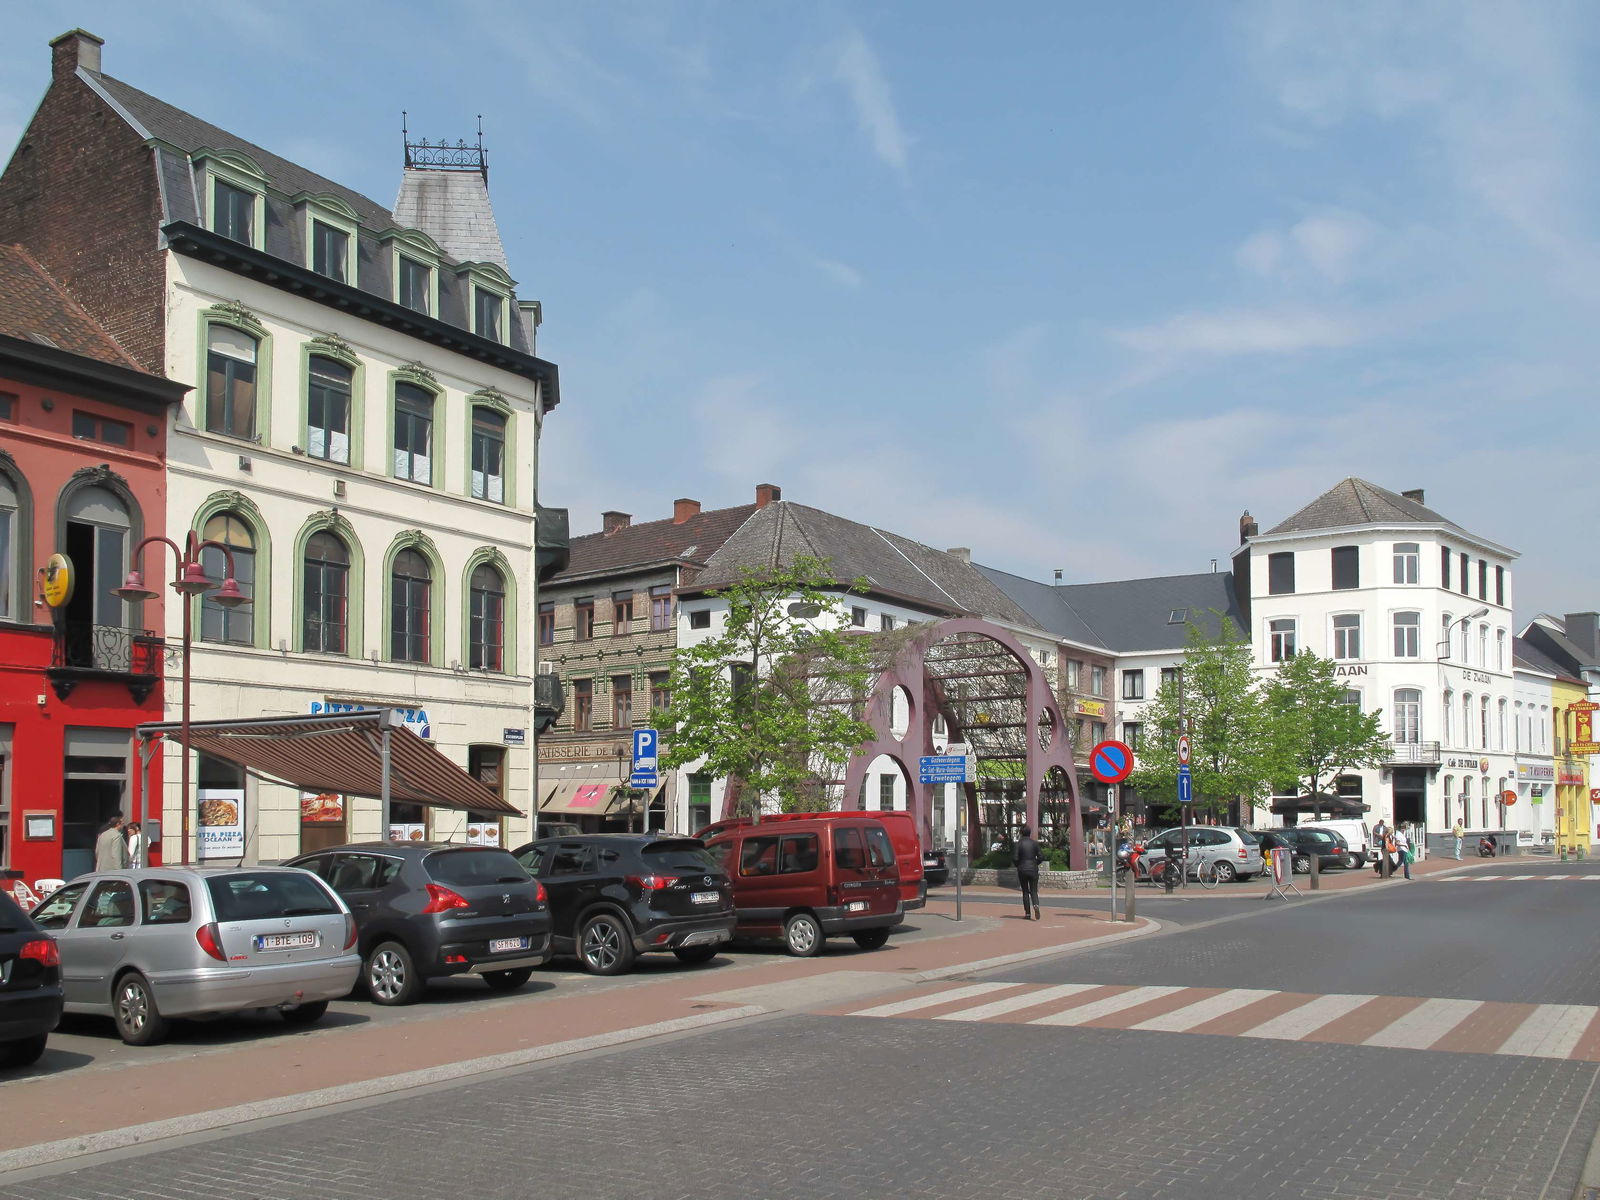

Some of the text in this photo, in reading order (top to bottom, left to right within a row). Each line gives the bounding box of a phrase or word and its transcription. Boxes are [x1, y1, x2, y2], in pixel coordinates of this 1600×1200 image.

[1332, 665, 1368, 677] AAN
[1463, 670, 1471, 680] DE
[638, 733, 652, 756] P
[596, 748, 608, 756] DE
[930, 775, 962, 783] Erwetegem
